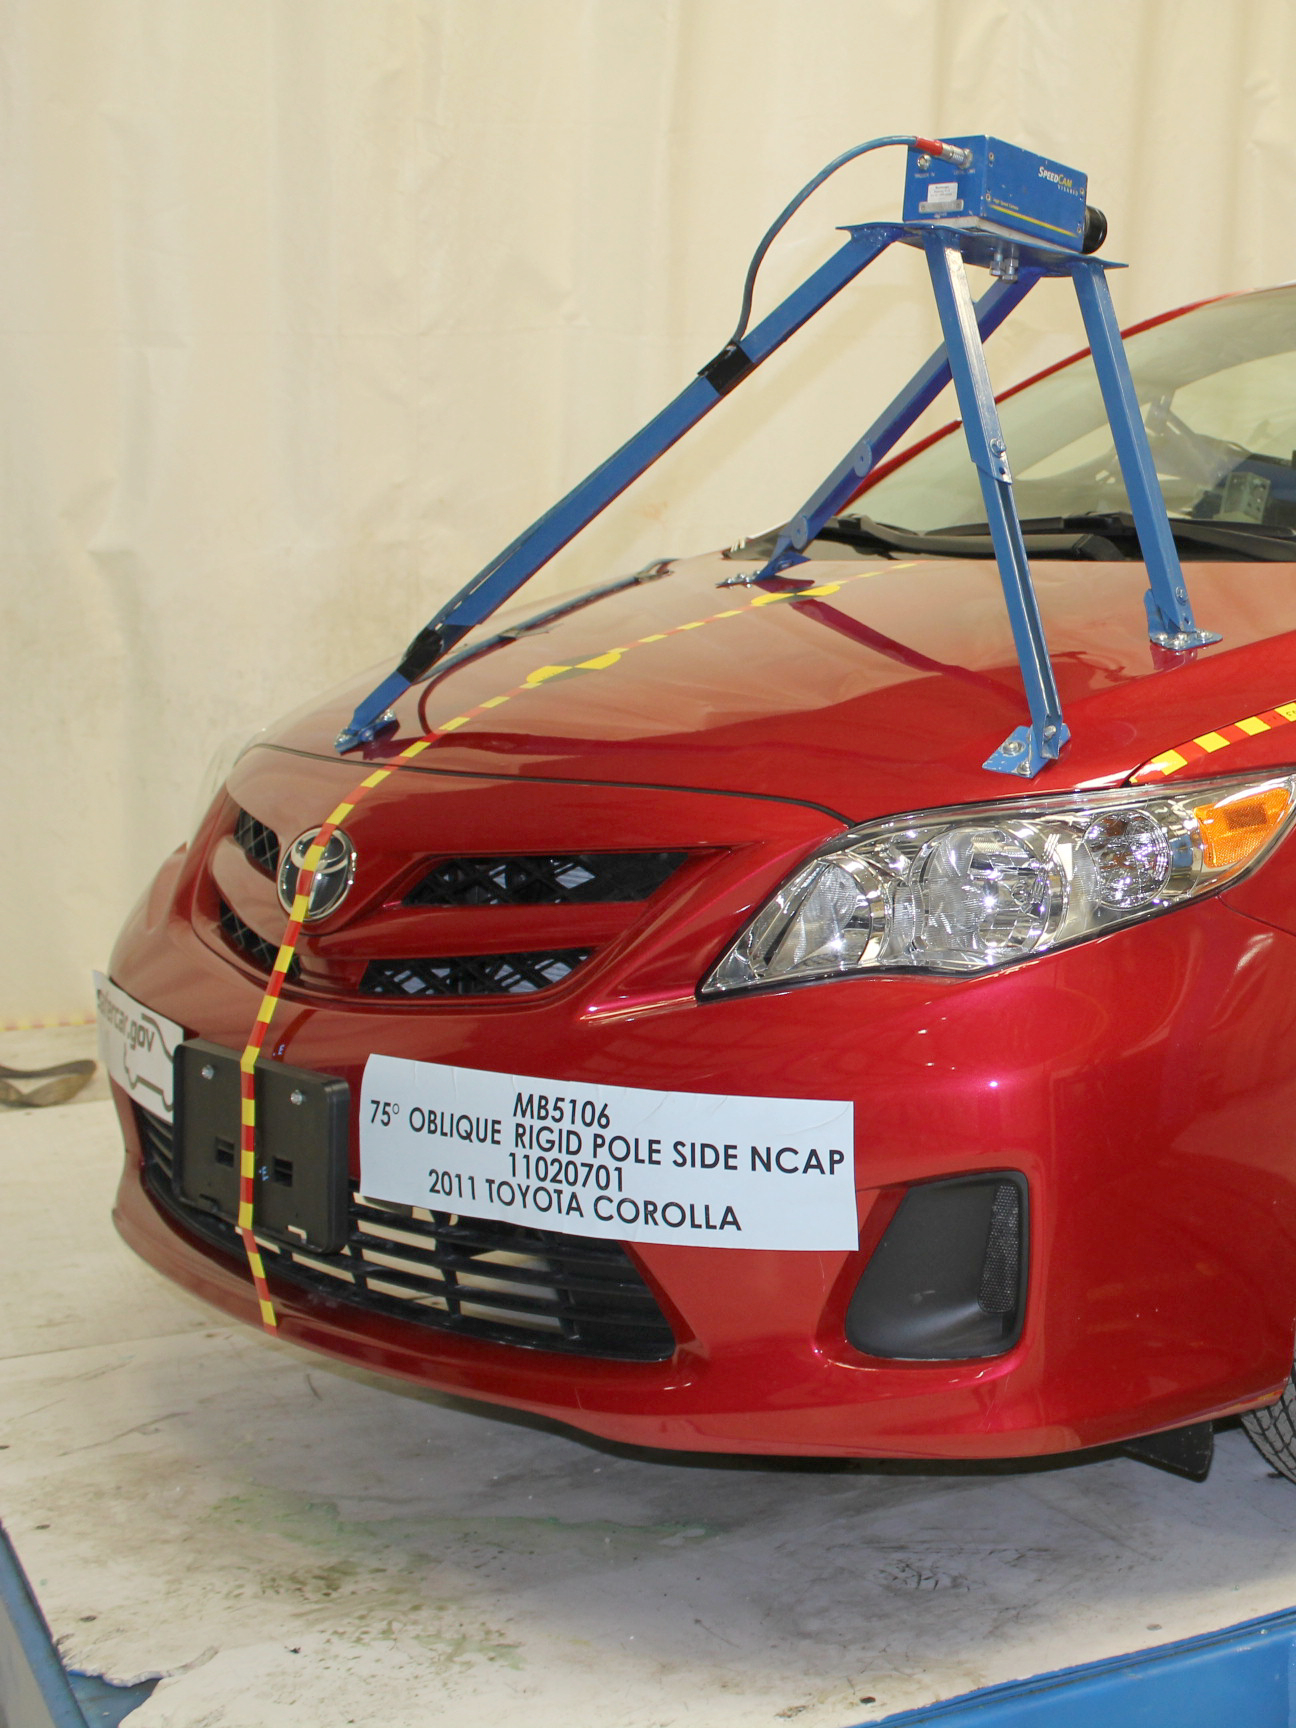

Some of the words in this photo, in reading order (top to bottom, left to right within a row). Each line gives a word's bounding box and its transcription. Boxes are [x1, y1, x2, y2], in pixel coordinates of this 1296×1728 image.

[512, 1092, 611, 1130] MB5106
[408, 1106, 502, 1145] OBLIQUE
[514, 1122, 583, 1156] RIGID
[592, 1132, 662, 1166] POLE
[672, 1140, 738, 1171] SIDE
[750, 1145, 845, 1176] NCAP
[508, 1152, 623, 1193] 11020701
[428, 1168, 476, 1200] 2011
[485, 1178, 584, 1218] TOYOTA
[593, 1194, 743, 1232] COROLLA
